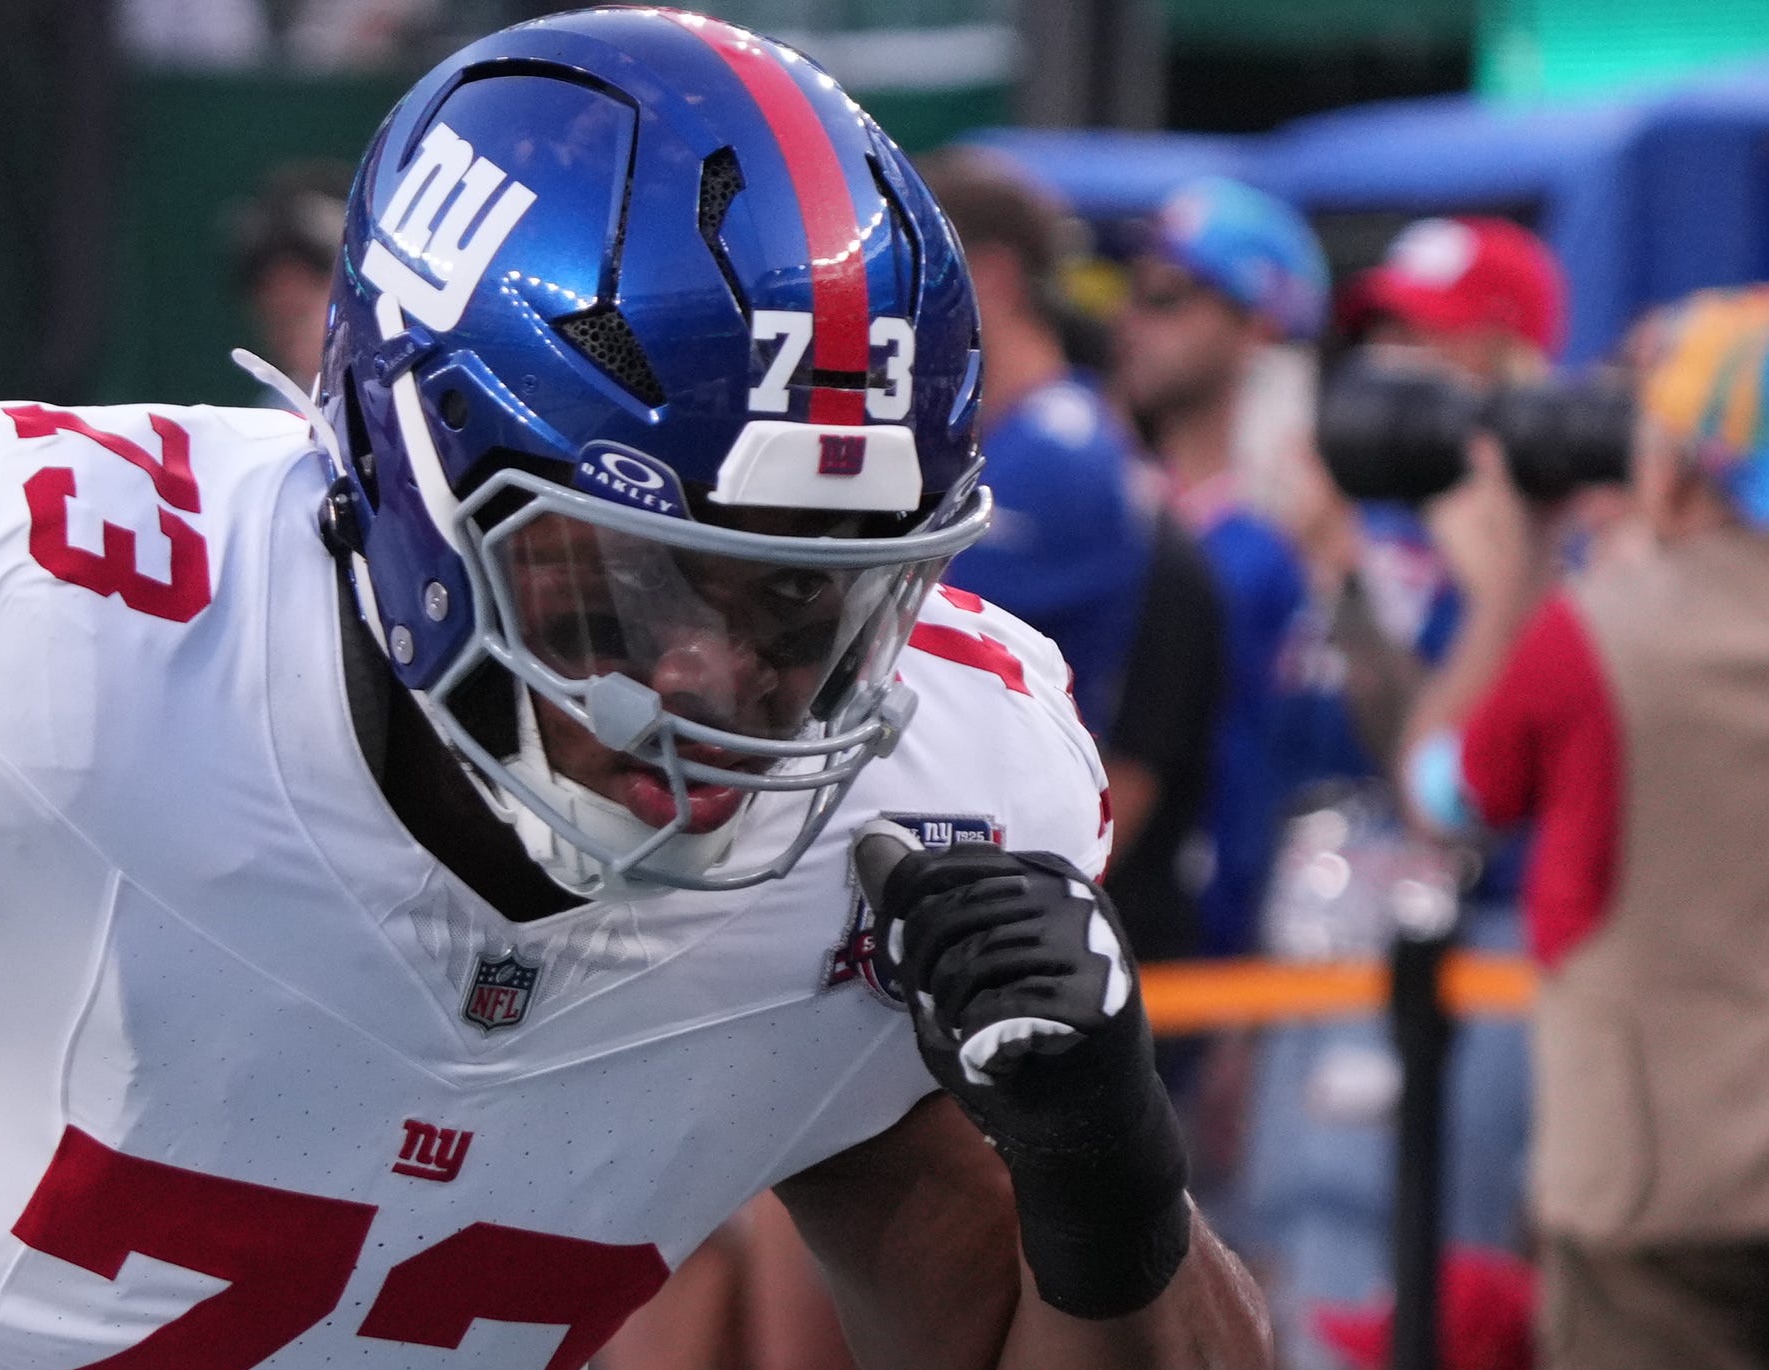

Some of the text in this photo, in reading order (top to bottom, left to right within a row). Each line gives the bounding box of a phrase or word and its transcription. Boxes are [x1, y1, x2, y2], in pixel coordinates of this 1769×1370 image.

[747, 309, 915, 420] 73
[580, 461, 674, 512] OAKLEY
[1, 404, 212, 624] 73
[955, 830, 985, 842] 1925
[470, 985, 520, 1022] NFL
